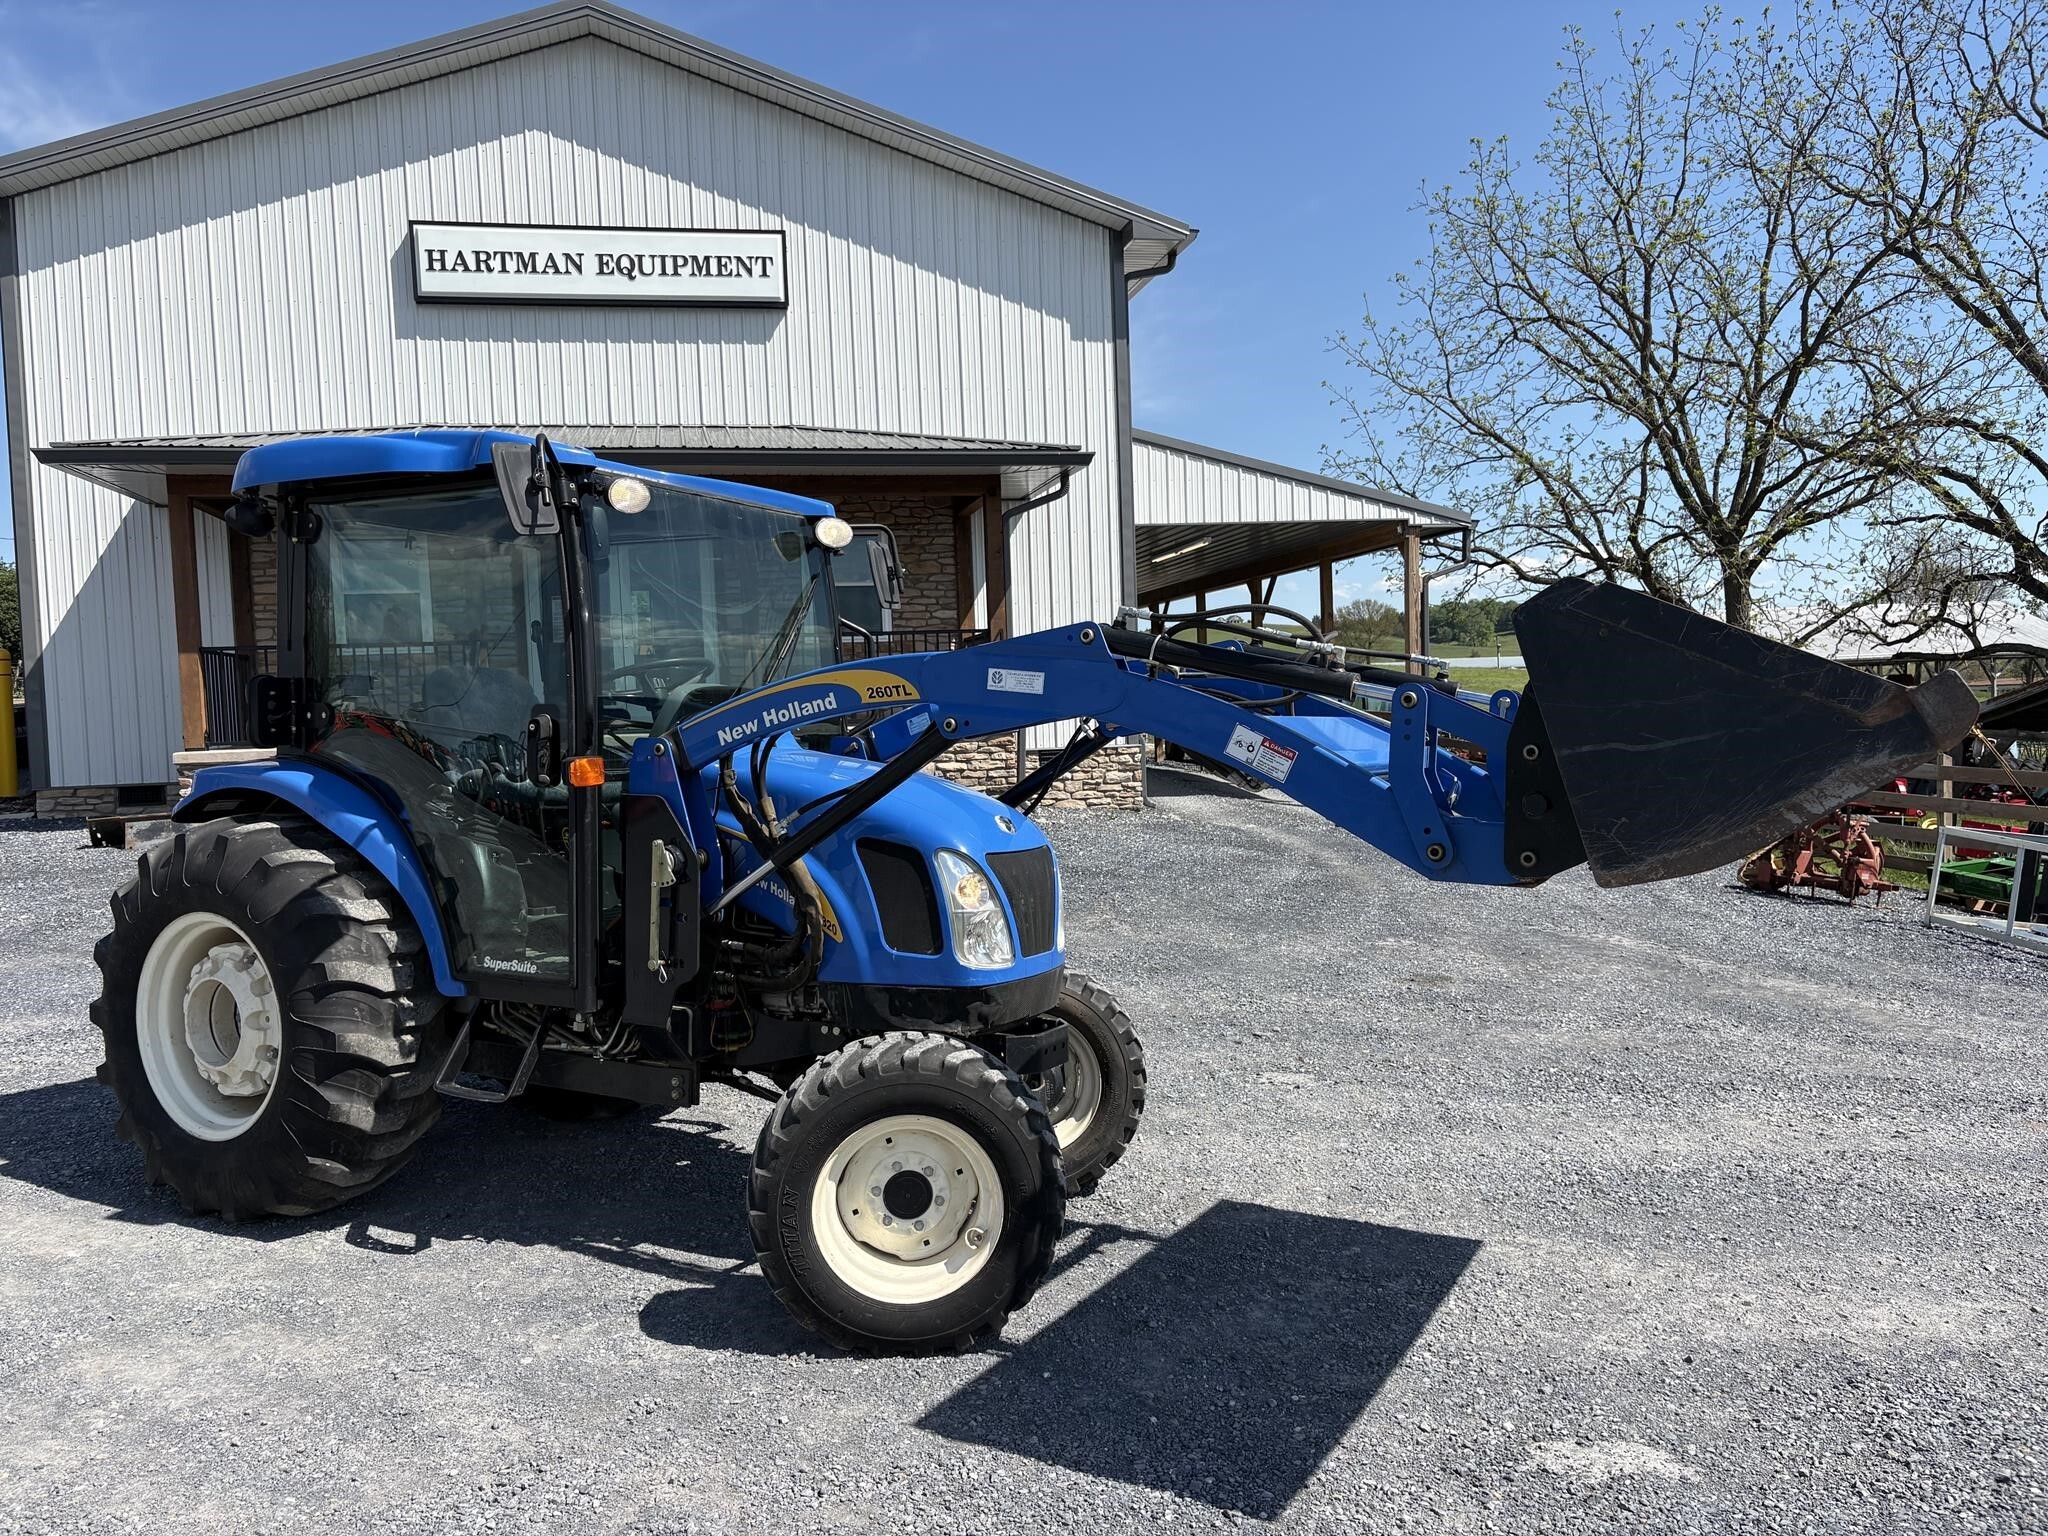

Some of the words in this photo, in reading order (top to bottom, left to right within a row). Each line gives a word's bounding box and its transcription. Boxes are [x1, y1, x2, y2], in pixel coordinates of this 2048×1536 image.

[425, 248, 584, 275] HARTMAN
[595, 253, 774, 281] EQUIPMENT
[866, 682, 912, 699] 260TL
[717, 718, 758, 747] New
[763, 692, 838, 728] Holland
[1270, 743, 1294, 757] DANGER
[771, 881, 795, 905] Holla
[483, 956, 537, 974] SuperSuite
[780, 1187, 811, 1278] TITAN
